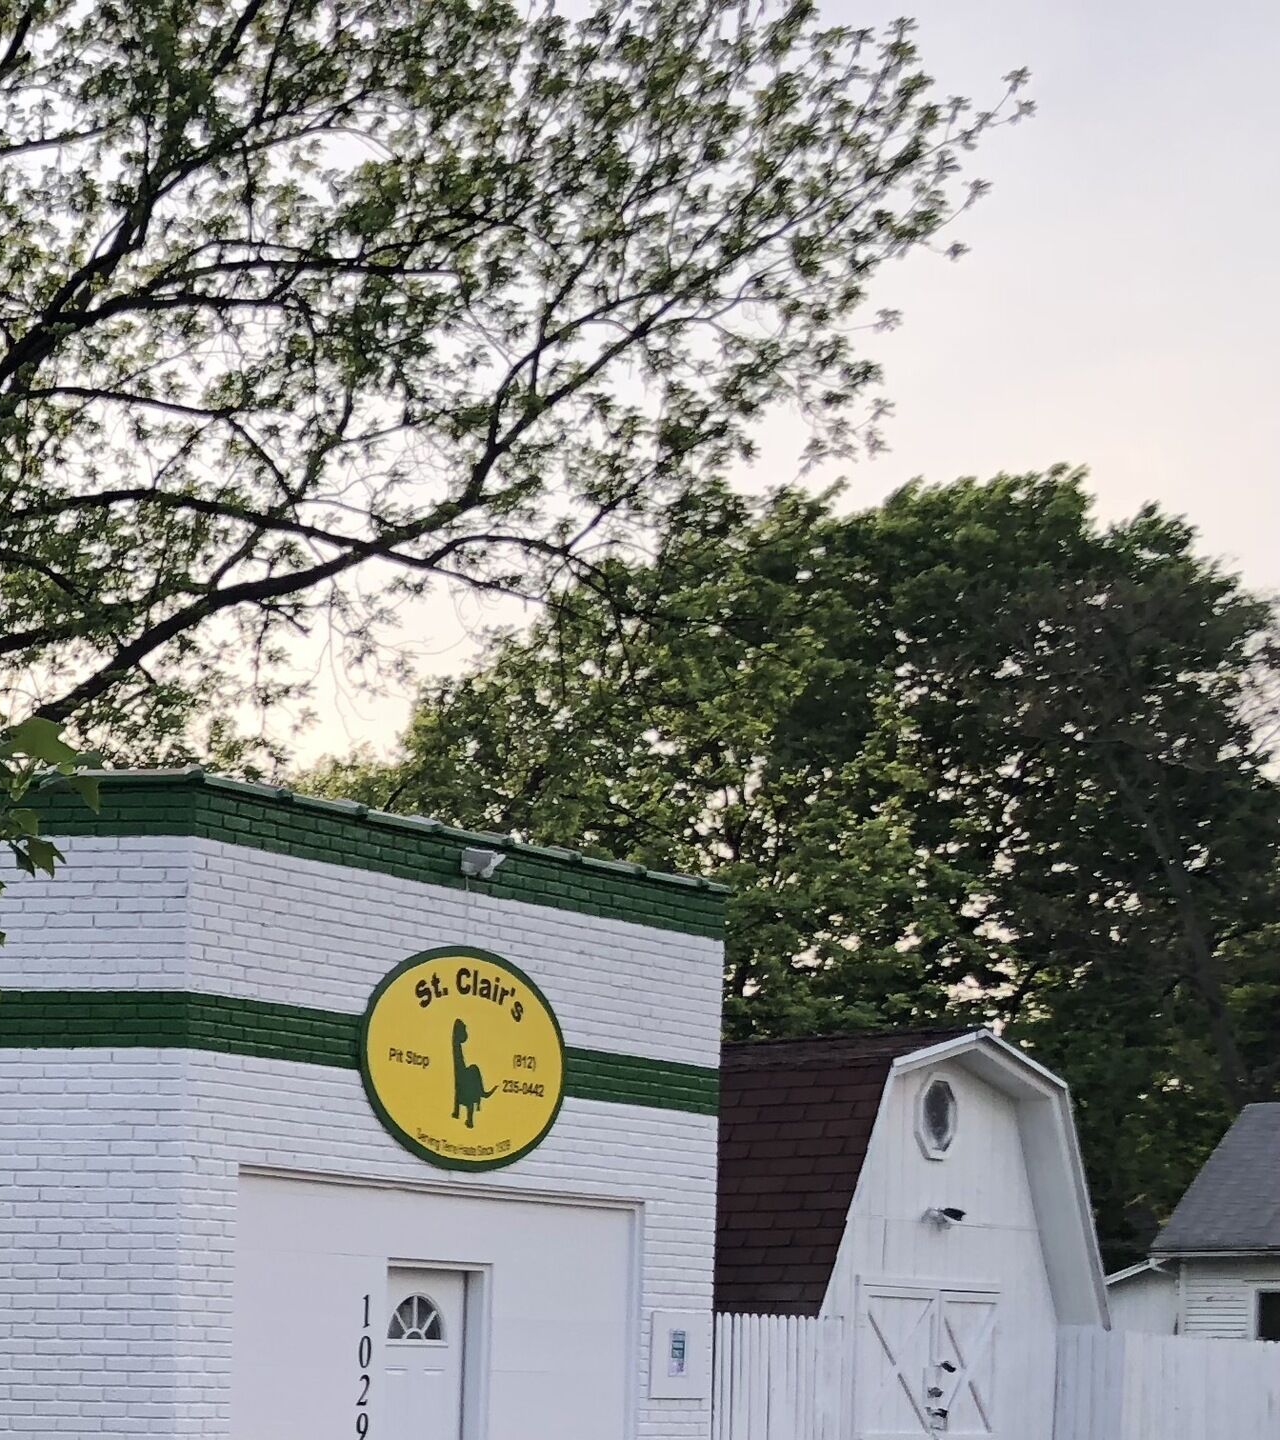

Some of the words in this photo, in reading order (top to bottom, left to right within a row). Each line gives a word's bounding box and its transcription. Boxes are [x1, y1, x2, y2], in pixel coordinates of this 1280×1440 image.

[415, 972, 449, 1009] St.
[456, 967, 524, 1023] Clair's
[389, 1047, 403, 1063] Pit
[405, 1050, 430, 1070] Stop
[513, 1054, 536, 1072] (812)
